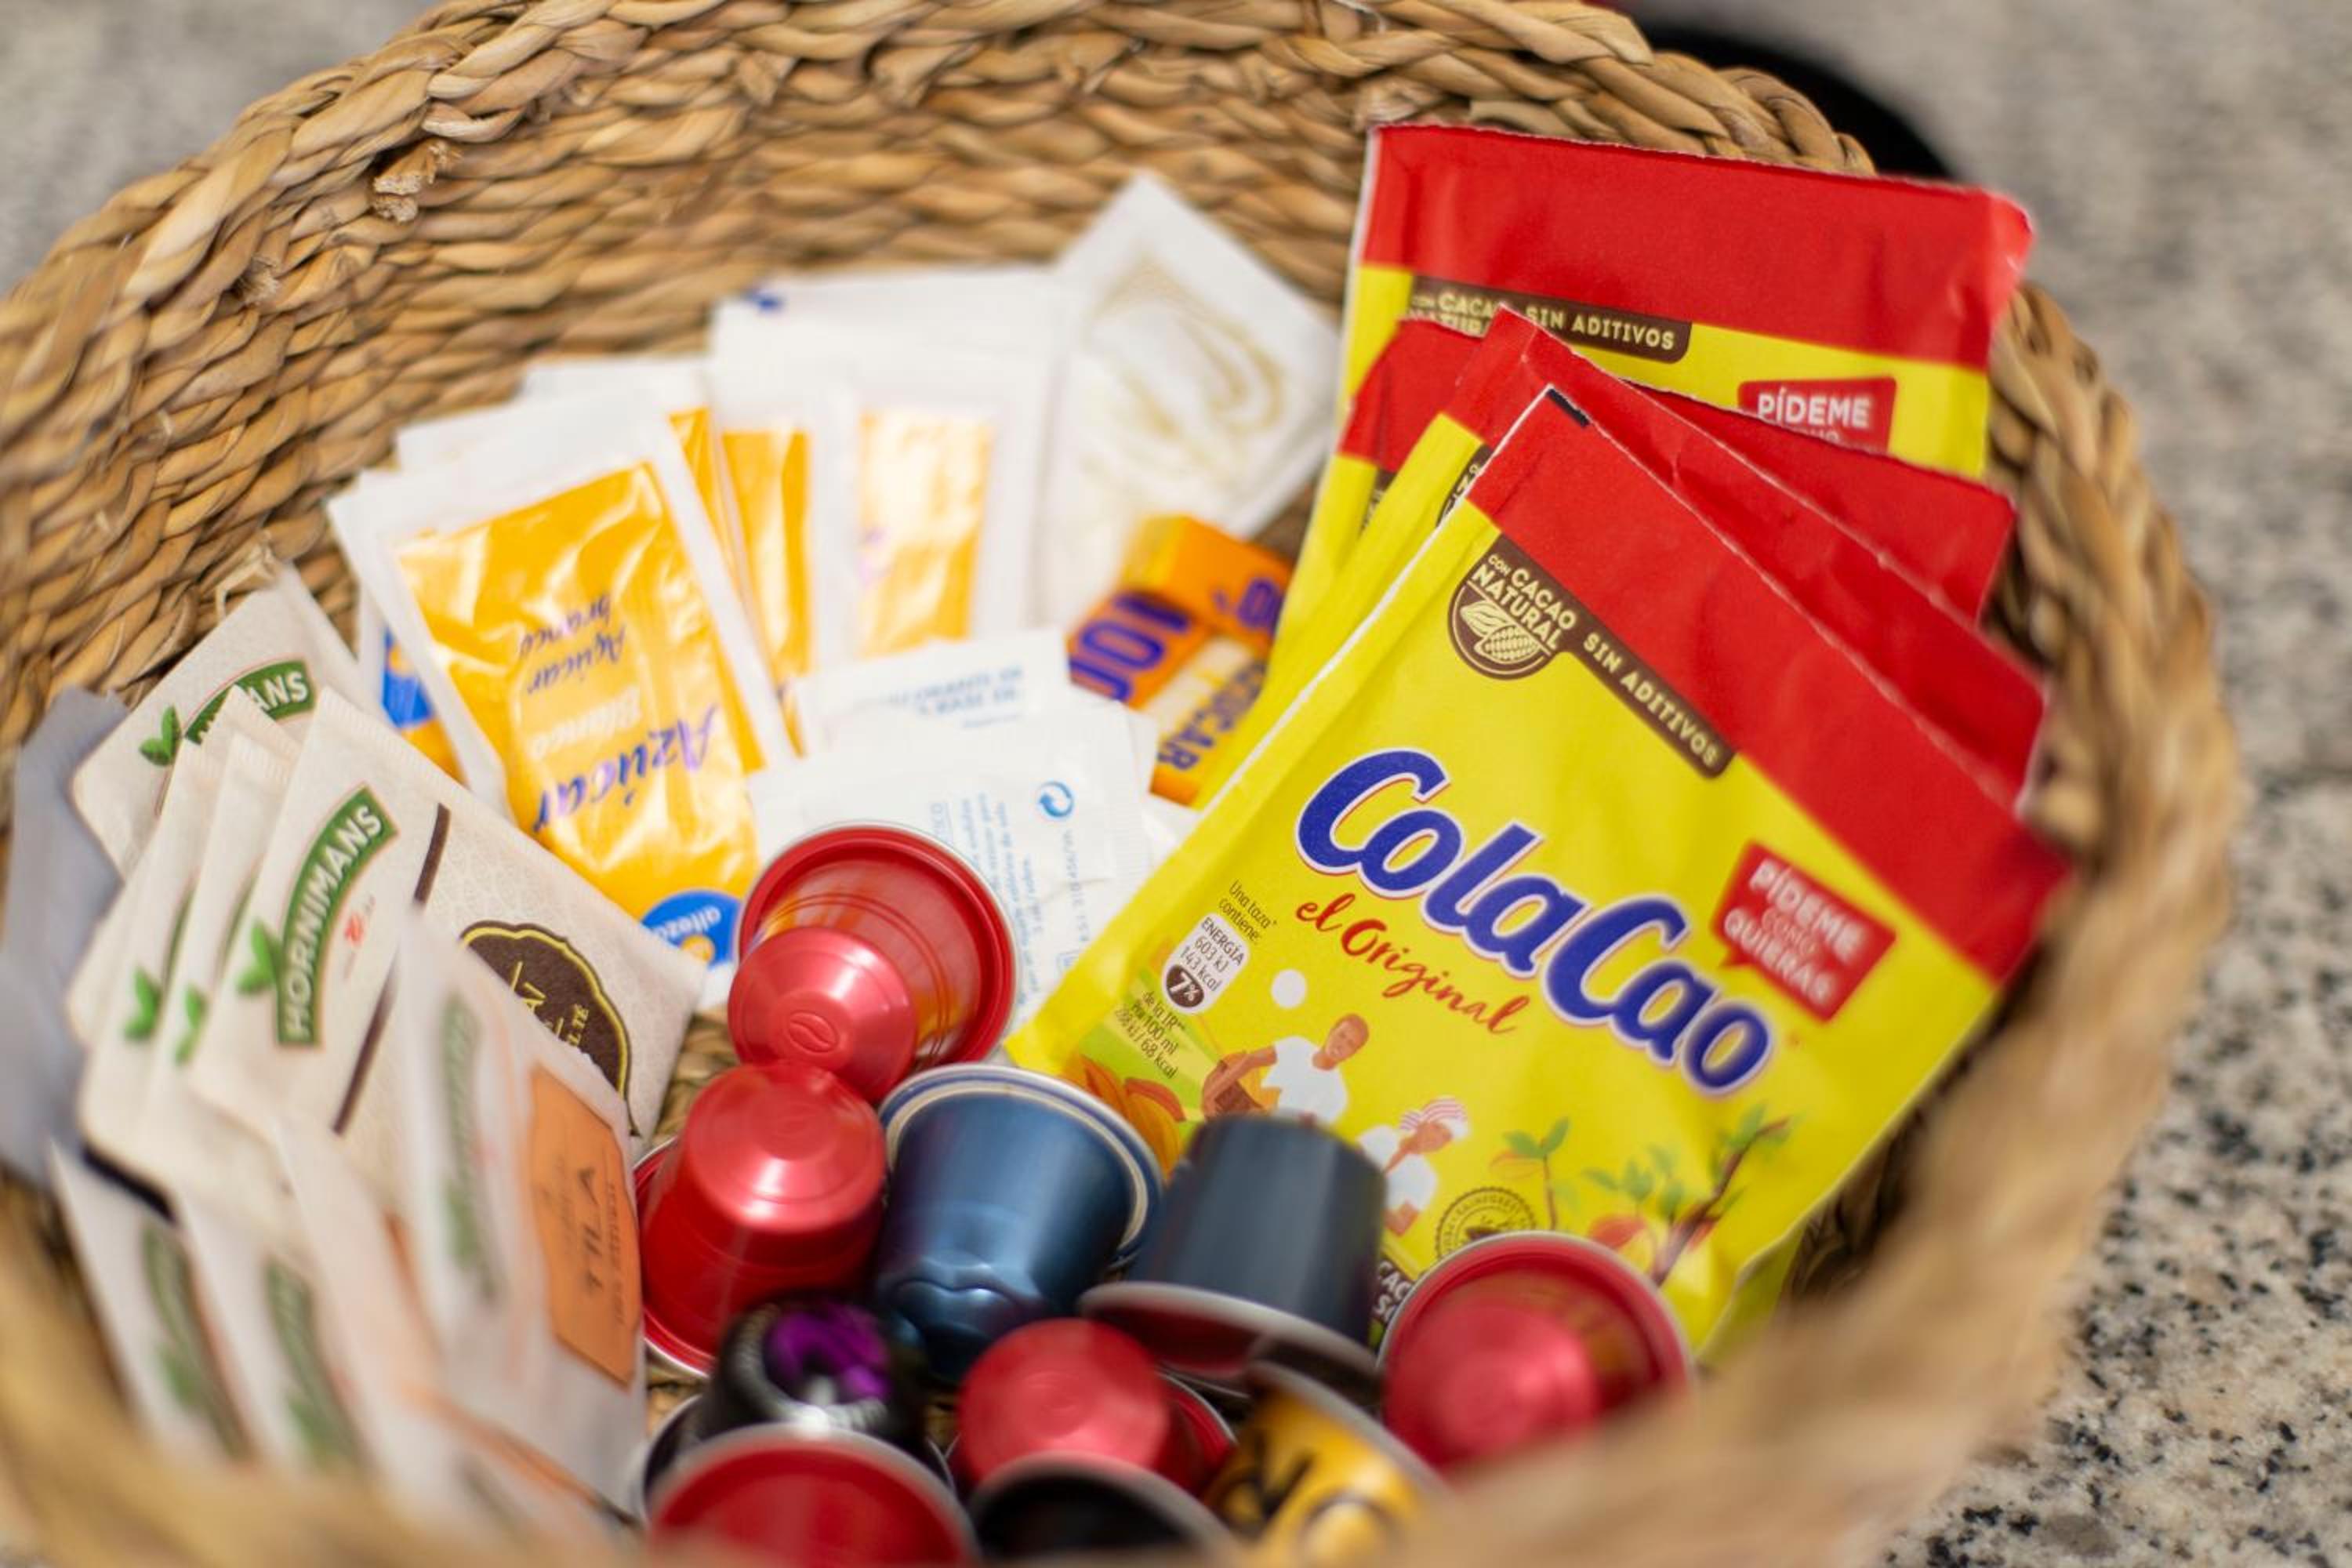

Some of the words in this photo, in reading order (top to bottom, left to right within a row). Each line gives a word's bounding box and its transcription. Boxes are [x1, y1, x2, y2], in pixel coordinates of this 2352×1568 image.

[1438, 290, 1497, 317] CACA
[1526, 306, 1566, 329] SIN
[1571, 313, 1675, 351] ADITIVOS
[1757, 385, 1871, 429] PÍDEME
[1472, 563, 1563, 651] NATURAL
[1487, 554, 1511, 575] CON
[1511, 568, 1577, 630] CACAO
[1582, 632, 1623, 674] SIN
[1619, 672, 1720, 768] ADITIVOS
[532, 702, 718, 833] Azúcar
[1229, 880, 1250, 906] Una
[1748, 857, 1864, 966] PÍDEME
[282, 805, 383, 1040] HORNIMANS
[1201, 916, 1245, 967] ENERGÍA
[1296, 748, 1773, 1094] ColaCao
[1179, 946, 1200, 974] 143
[1197, 965, 1221, 992] kcal
[1195, 935, 1217, 963] 603
[1295, 892, 1356, 934] el
[1340, 918, 1531, 1036] Original
[1723, 908, 1835, 1008] QUIERAS
[1169, 970, 1200, 1002] 7%
[1142, 1016, 1164, 1041] 100
[1376, 1259, 1414, 1300] CAC
